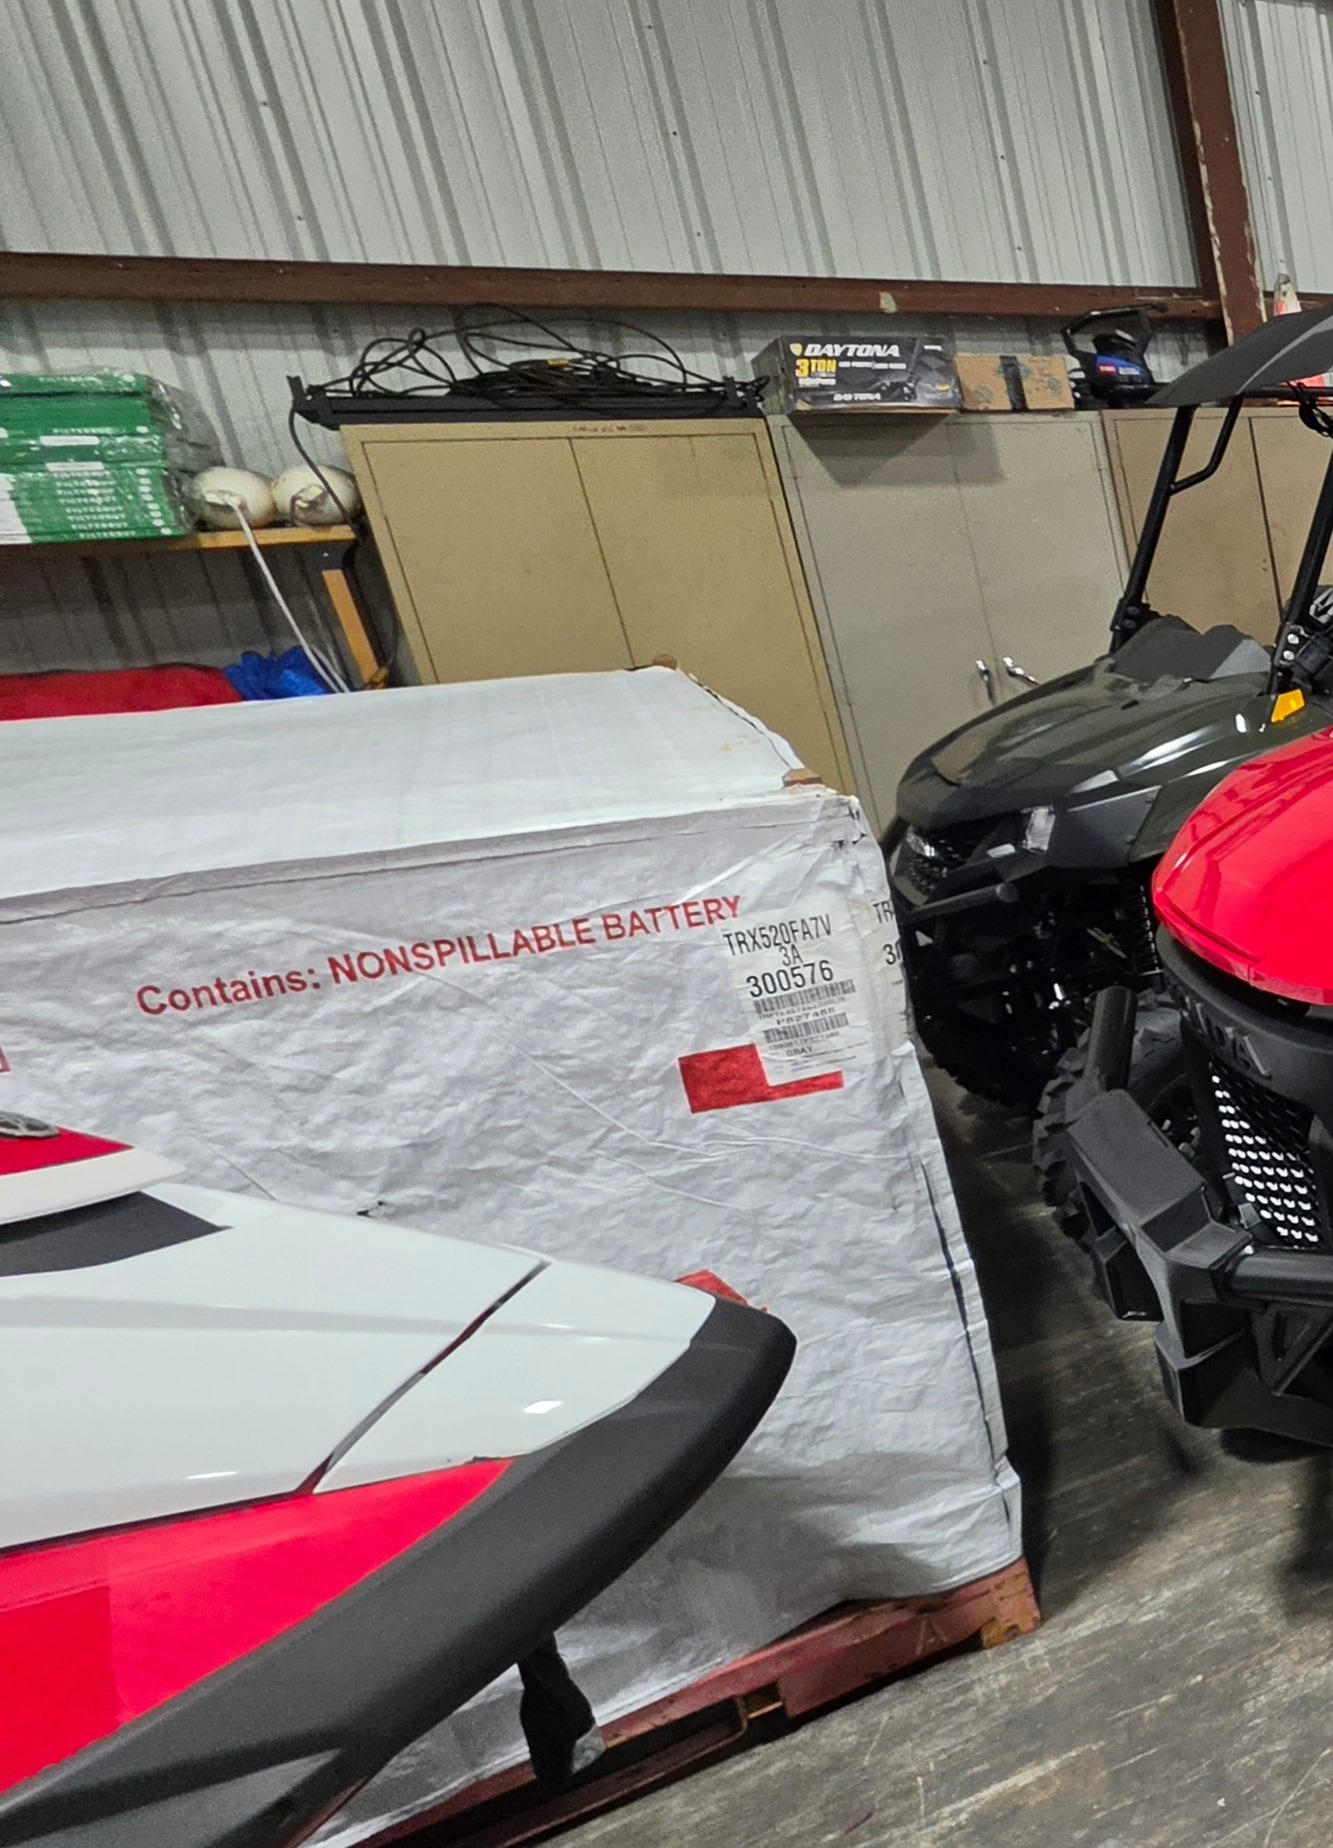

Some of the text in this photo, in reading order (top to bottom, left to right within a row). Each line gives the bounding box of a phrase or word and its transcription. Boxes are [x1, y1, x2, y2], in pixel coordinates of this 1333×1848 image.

[804, 344, 900, 357] DAYTONA
[795, 358, 809, 378] 3
[810, 359, 837, 373] TON
[723, 914, 832, 956] TRX520FA7V
[136, 894, 741, 1015] Contains: NONSPILLABLE BATTERY
[778, 943, 804, 967] 3A
[746, 959, 834, 998] 300576
